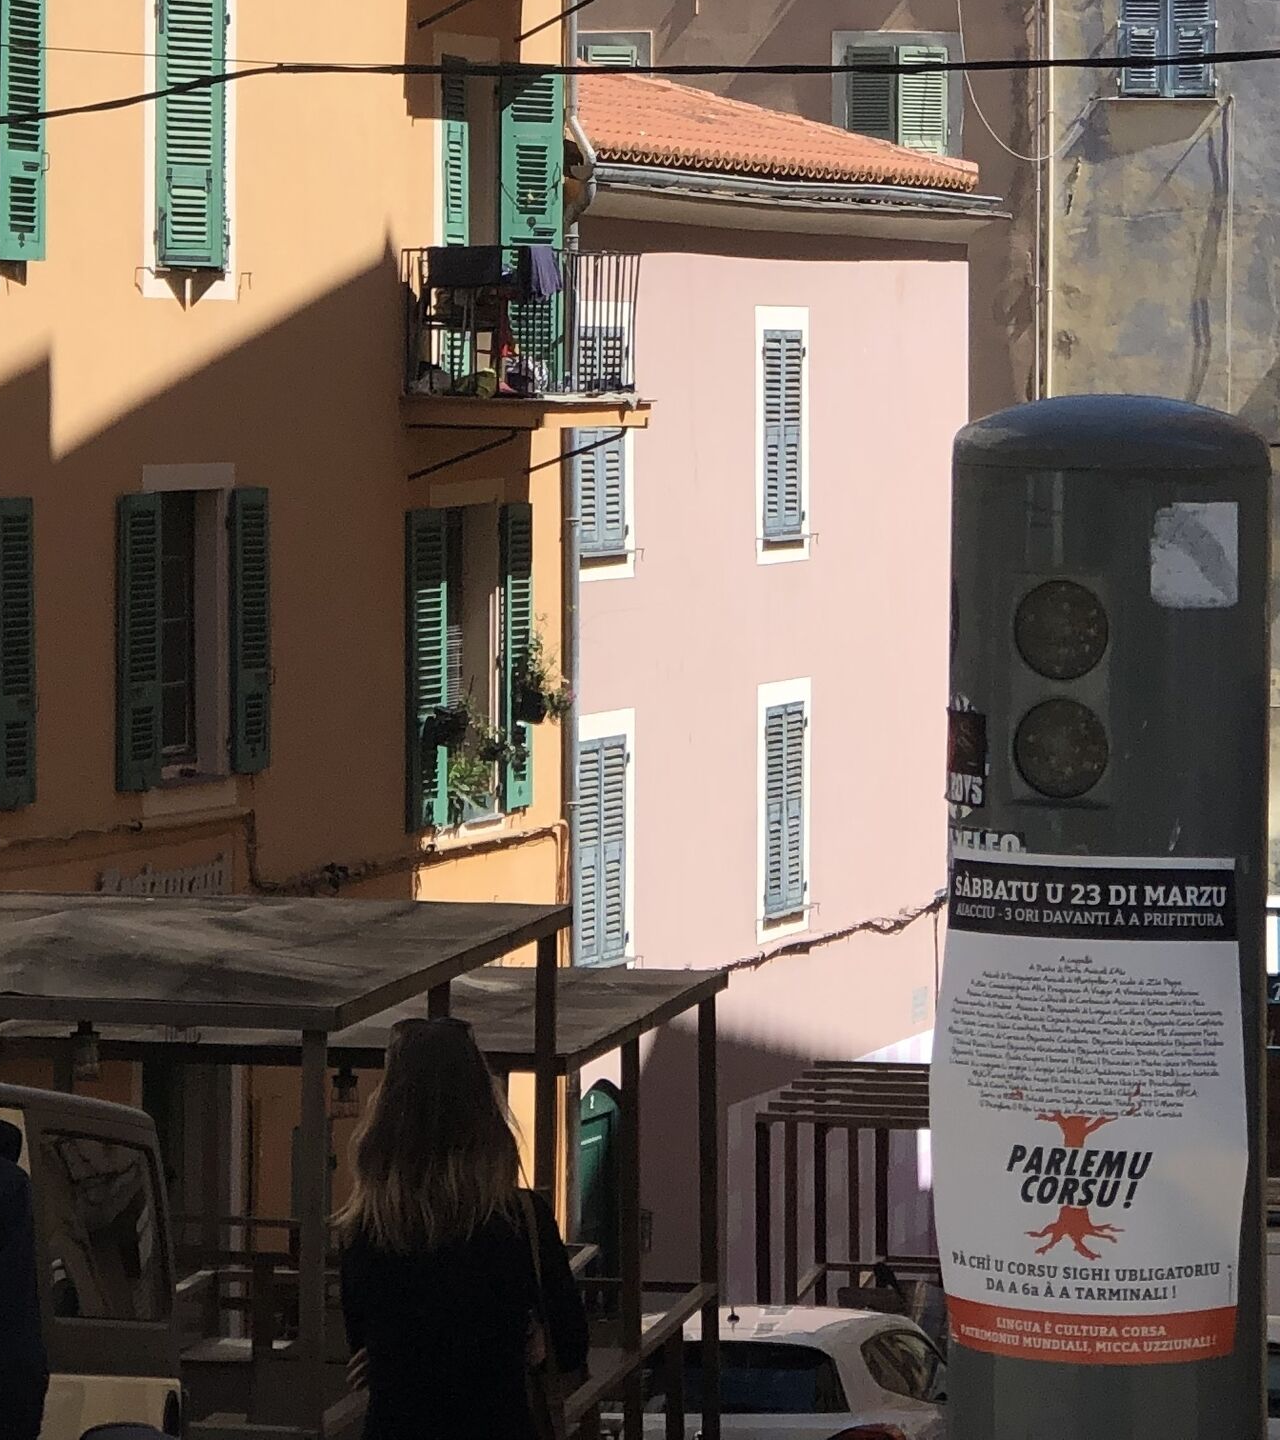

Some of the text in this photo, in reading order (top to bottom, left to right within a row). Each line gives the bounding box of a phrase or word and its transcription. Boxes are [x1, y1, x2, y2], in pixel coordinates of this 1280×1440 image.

[955, 871, 1227, 908] SÀBBATU U 23 DI MARZU
[1005, 907, 1012, 920] 3
[1015, 908, 1039, 923] ORI
[1042, 910, 1110, 926] DAVANTI
[1127, 912, 1140, 927] A
[1143, 912, 1224, 927] PRIFITTURA
[1006, 1144, 1153, 1179] PARLEMU
[1020, 1175, 1121, 1207] CORSU
[951, 1250, 967, 1266] PÀ
[994, 1259, 1004, 1272] U
[1007, 1261, 1058, 1279] CORSU
[1062, 1265, 1111, 1282] SIGHI
[1115, 1261, 1221, 1283] UBLIGATORIU
[985, 1277, 1005, 1293] DA
[1007, 1280, 1019, 1294] A
[1021, 1282, 1040, 1297] 6a
[1058, 1286, 1071, 1299] A
[1074, 1287, 1169, 1301] TARMINALI
[996, 1316, 1041, 1333] LINGUA
[1055, 1324, 1118, 1338] CULTURA
[1121, 1325, 1168, 1337] CORSA
[1023, 1336, 1093, 1355] MUNDIALI,
[1095, 1341, 1140, 1354] MICCA
